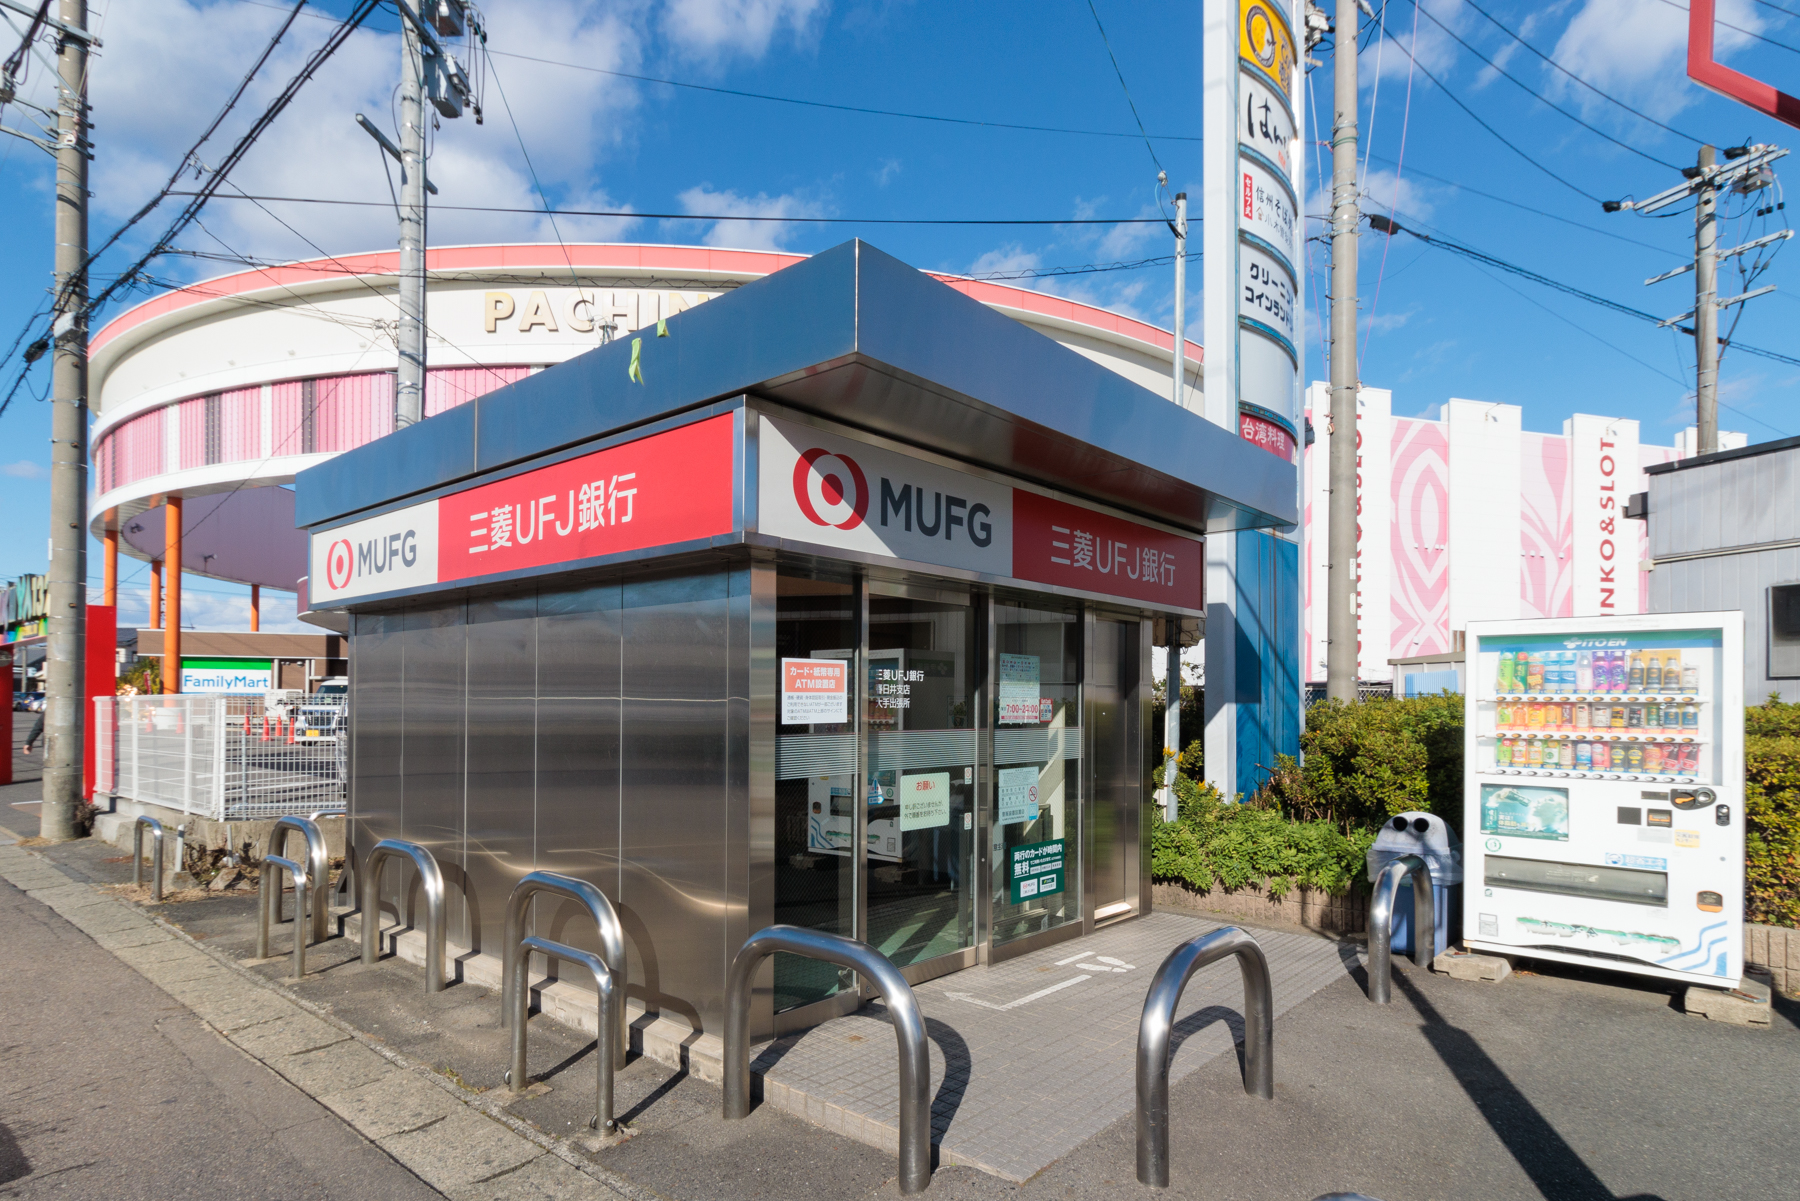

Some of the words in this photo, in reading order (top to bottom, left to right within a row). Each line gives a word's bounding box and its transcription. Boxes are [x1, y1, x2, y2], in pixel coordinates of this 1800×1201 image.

[1244, 177, 1252, 217] セルフ式
[1241, 417, 1285, 451] 台湾料理
[469, 472, 638, 554] 三菱UFJ銀行
[880, 477, 992, 548] MUFG
[1600, 437, 1615, 616] NKO&SLOT
[357, 529, 417, 577] MUFG
[1050, 525, 1176, 587] 三菱UFJ銀行
[183, 674, 269, 690] FamilyMart
[794, 679, 836, 689] ATM設置店
[875, 669, 925, 681] 三菱UFJ銀行
[916, 780, 936, 791] お願い
[1013, 860, 1029, 876] 無料
